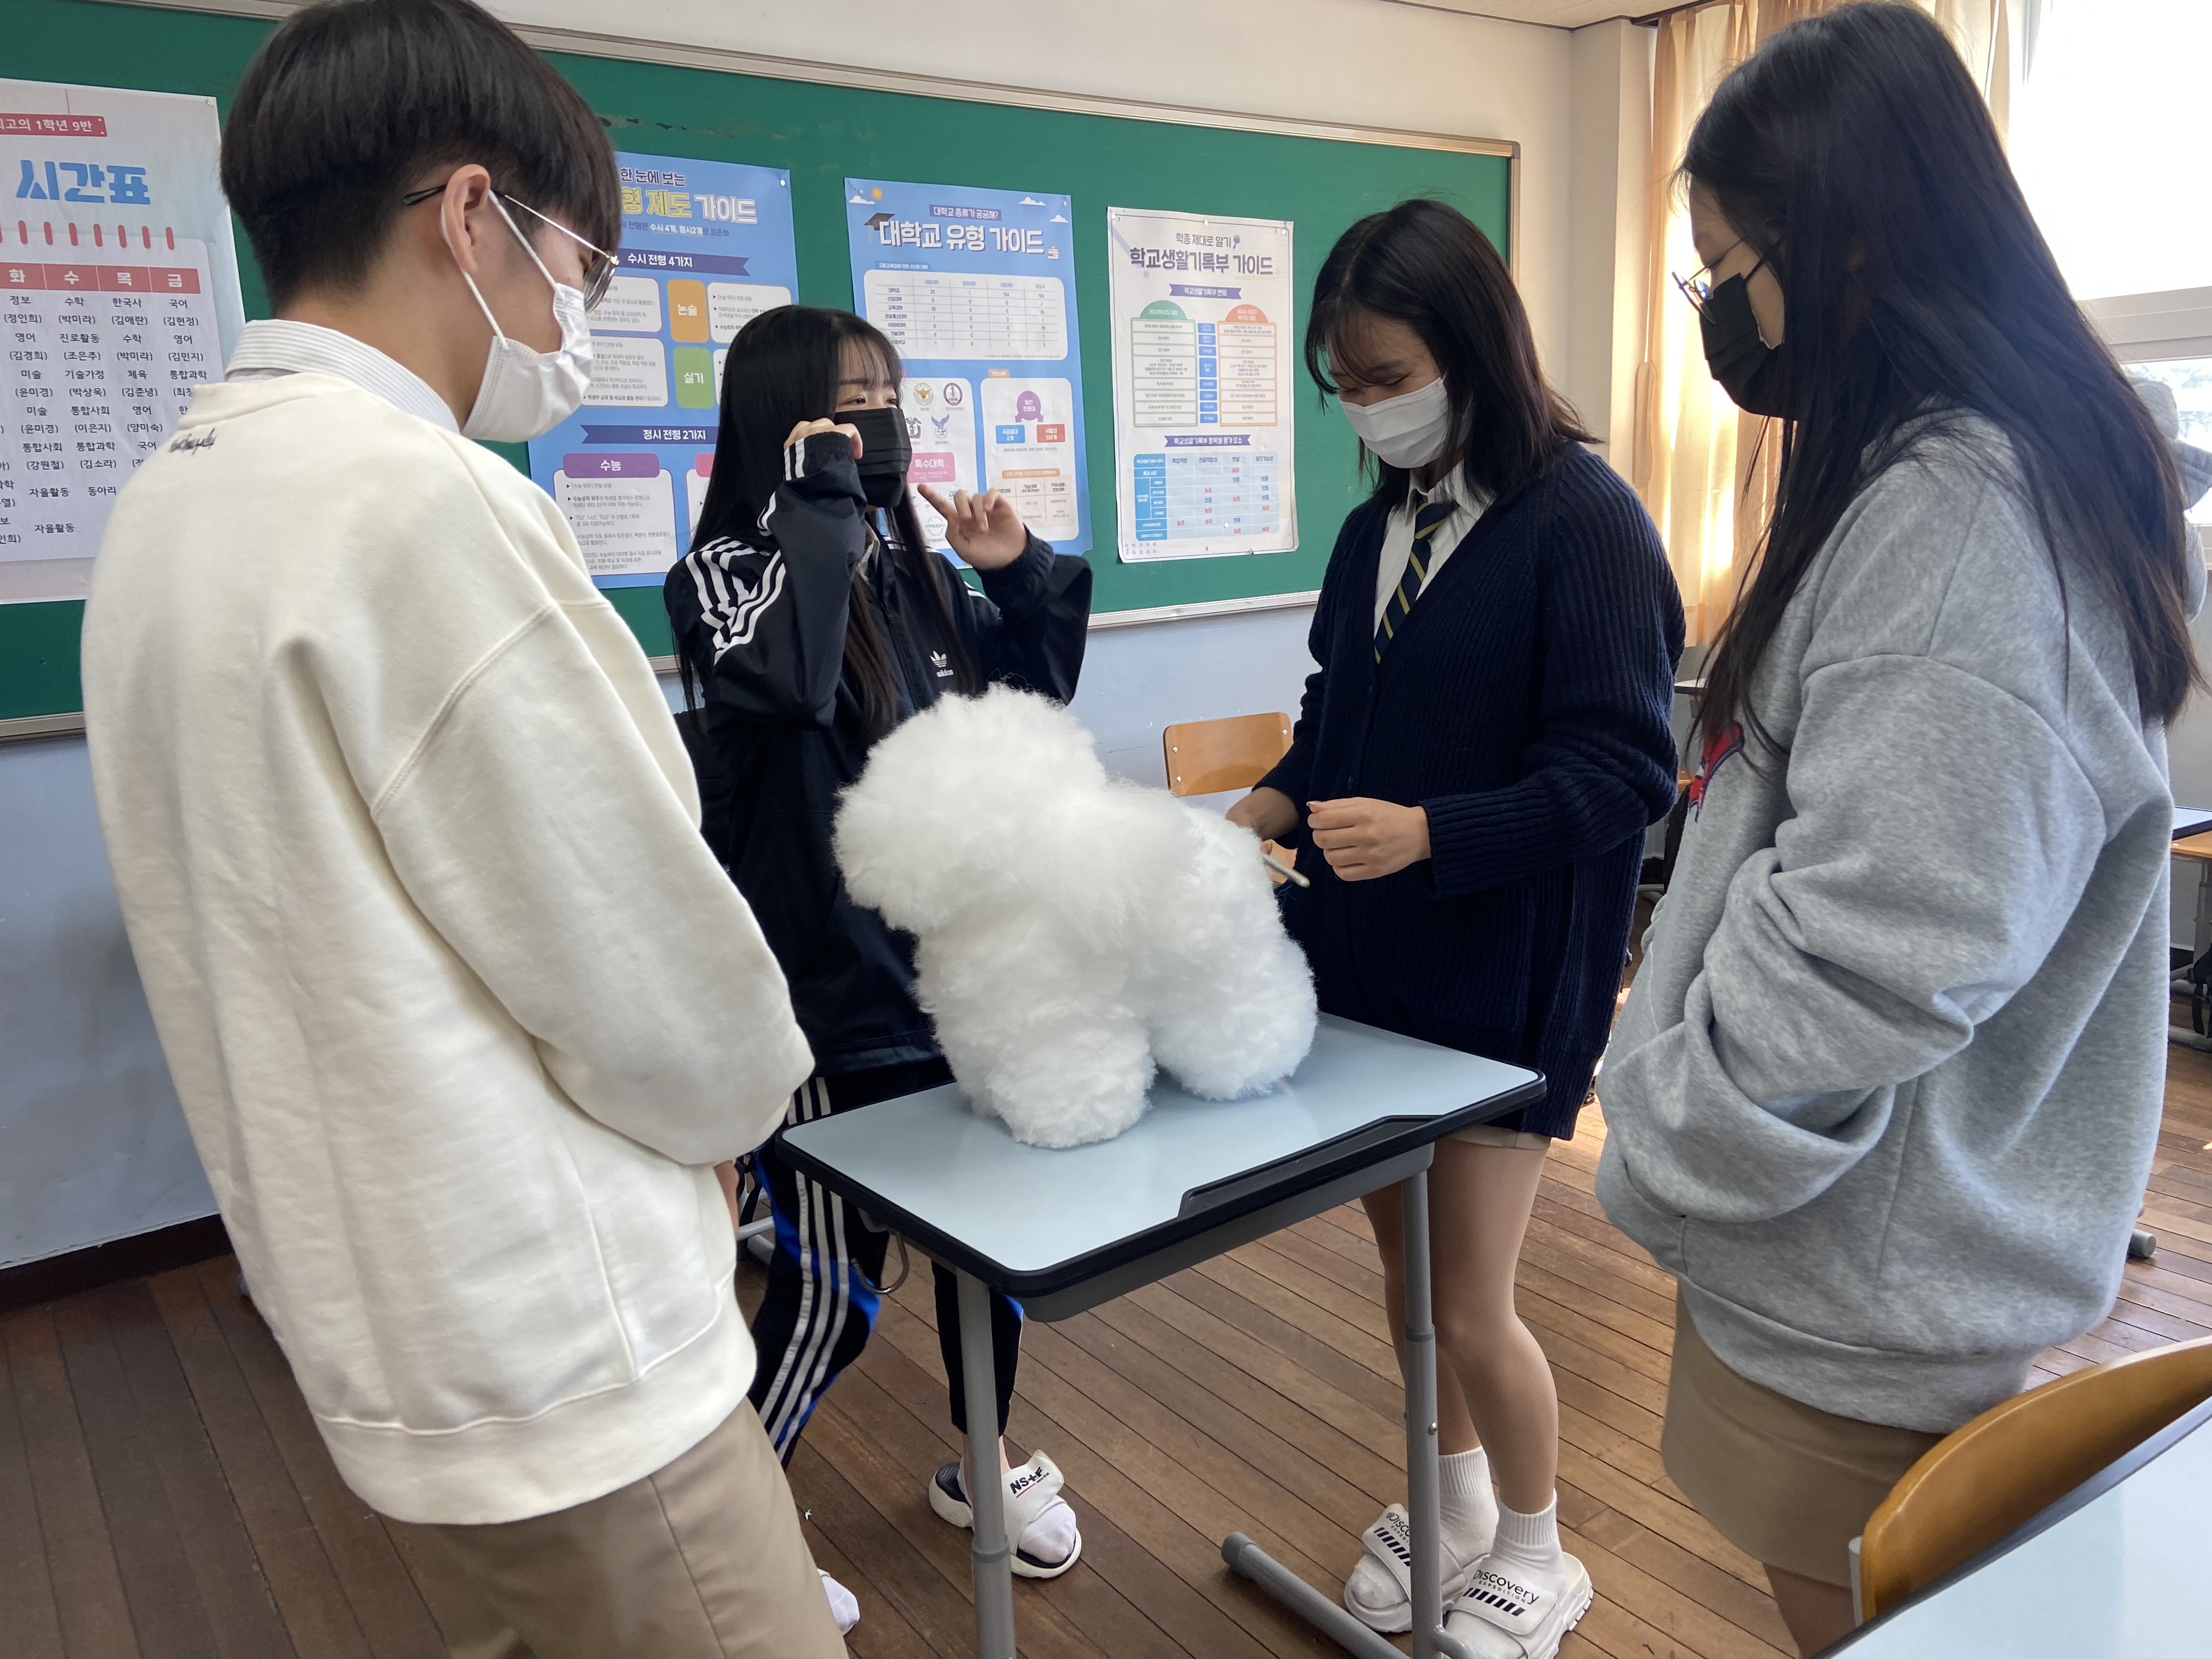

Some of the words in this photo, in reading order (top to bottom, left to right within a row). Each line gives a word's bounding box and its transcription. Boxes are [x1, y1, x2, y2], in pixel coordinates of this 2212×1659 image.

[36, 119, 67, 132] 1학년
[73, 120, 92, 132] 9반
[16, 160, 150, 205] 시간표
[620, 167, 632, 182] 한
[635, 169, 659, 184] 눈에
[662, 172, 686, 187] 보는
[646, 190, 692, 218] 제도
[694, 194, 758, 224] 가이드
[934, 207, 953, 217] 대학교
[955, 208, 975, 218] 종류가
[977, 209, 998, 219] 궁금해?
[650, 223, 663, 232] 수시
[879, 221, 942, 248] 대학교
[946, 225, 985, 251] 유형
[990, 228, 1044, 254] 가이드
[1176, 232, 1190, 245] 학종
[1192, 235, 1214, 247] 제대로
[1215, 236, 1231, 248] 알기
[628, 253, 646, 264] 수시
[648, 254, 667, 266] 전형
[668, 256, 693, 268] 4가지
[1130, 247, 1229, 274] 학교생활기록부
[1233, 255, 1273, 275] 가이드
[8, 269, 25, 283] 화
[64, 271, 80, 285] 수
[116, 272, 132, 286] 목
[167, 274, 183, 287] 금
[9, 296, 31, 305] 정보
[64, 297, 84, 307] 수학
[112, 297, 142, 308] 한국사
[169, 300, 188, 309] 국어
[677, 303, 698, 317] 논술
[4, 314, 42, 324] (정인희)
[58, 315, 95, 325] (박미라)
[112, 316, 148, 326] (김애란)
[163, 317, 199, 326] (김현정)
[15, 333, 36, 343] 영어
[59, 333, 100, 343] 진로활동
[122, 334, 142, 344] 수학
[173, 335, 193, 345] 영어
[9, 351, 47, 361] (김경희)
[64, 352, 101, 362] (조은주)
[116, 352, 153, 362] (박미라)
[168, 352, 204, 362] (김민지)
[21, 370, 42, 380] 미술
[65, 370, 104, 380] 기술가정
[127, 370, 147, 380] 체육
[169, 370, 207, 380] 통합과학
[684, 371, 704, 384] 실기
[15, 388, 53, 398] (윤미경)
[69, 387, 106, 397] (박상욱)
[27, 406, 47, 415] 미술
[71, 405, 110, 415] 통합사회
[132, 405, 151, 415] 영어
[21, 424, 59, 435] (윤미경)
[75, 424, 111, 433] (이은지)
[127, 424, 163, 433] (양미숙)
[642, 429, 661, 441] 정시
[663, 429, 681, 441] 전형
[682, 429, 706, 441] 2가지
[22, 442, 63, 453] 통합사회
[76, 442, 116, 452] 통합과학
[137, 441, 156, 450] 국어
[26, 460, 64, 470] (강원철)
[80, 460, 117, 469] (김소라)
[600, 459, 622, 471] 수능
[29, 487, 70, 498] 자율활동
[88, 487, 117, 496] 동아리
[34, 523, 75, 533] 자율활동
[0, 535, 21, 544] 인희)
[1479, 1580, 1526, 1603] EXPEDITION
